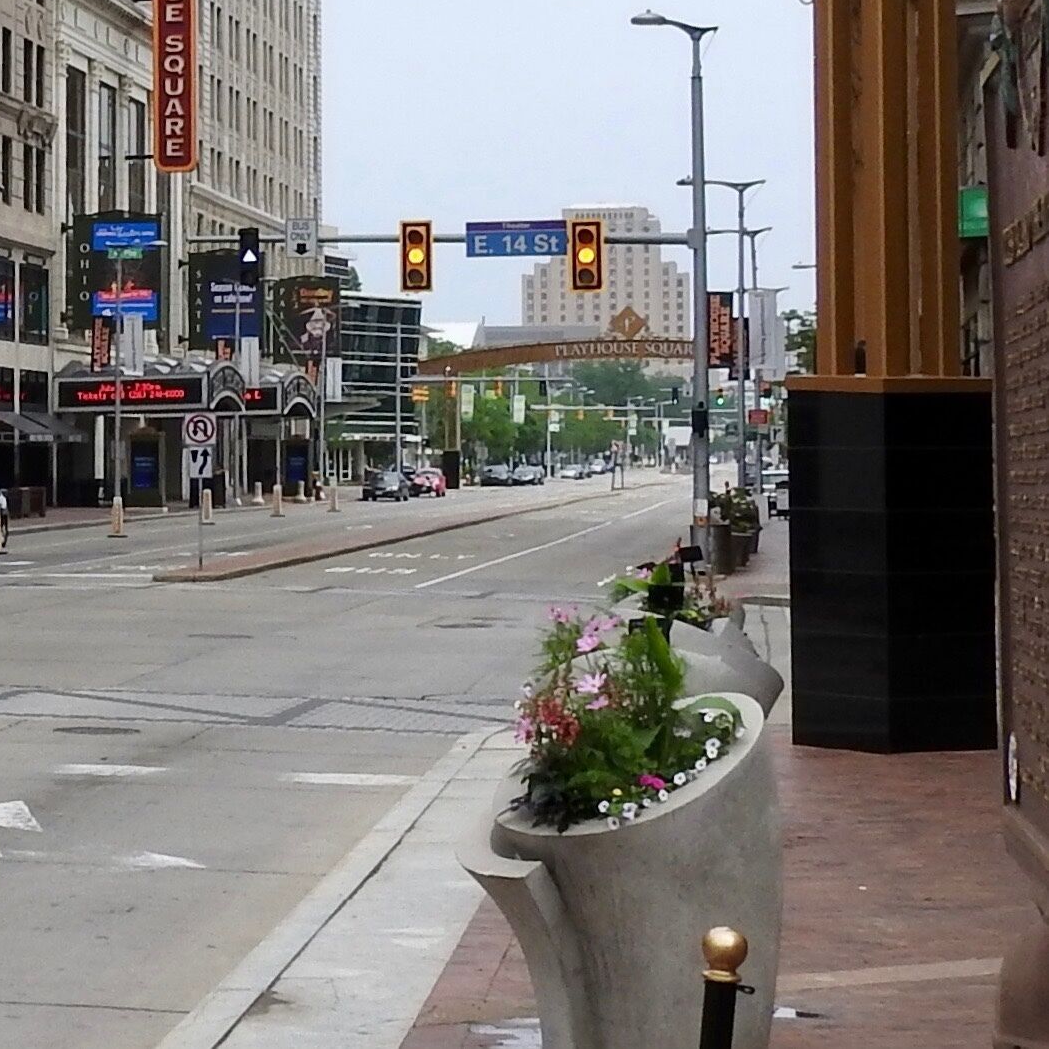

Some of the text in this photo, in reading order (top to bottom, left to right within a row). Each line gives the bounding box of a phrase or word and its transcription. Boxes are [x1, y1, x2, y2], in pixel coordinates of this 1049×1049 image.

[163, 33, 184, 157] SQUARE
[291, 232, 311, 241] ONLY
[292, 222, 310, 231] BUS
[474, 234, 559, 255] E. 14 St
[79, 243, 91, 301] OHIO
[709, 294, 721, 365] PLAYHOUSE
[720, 306, 731, 354] SQUARE
[554, 341, 693, 357] PLAYHOUSE SQUAR
